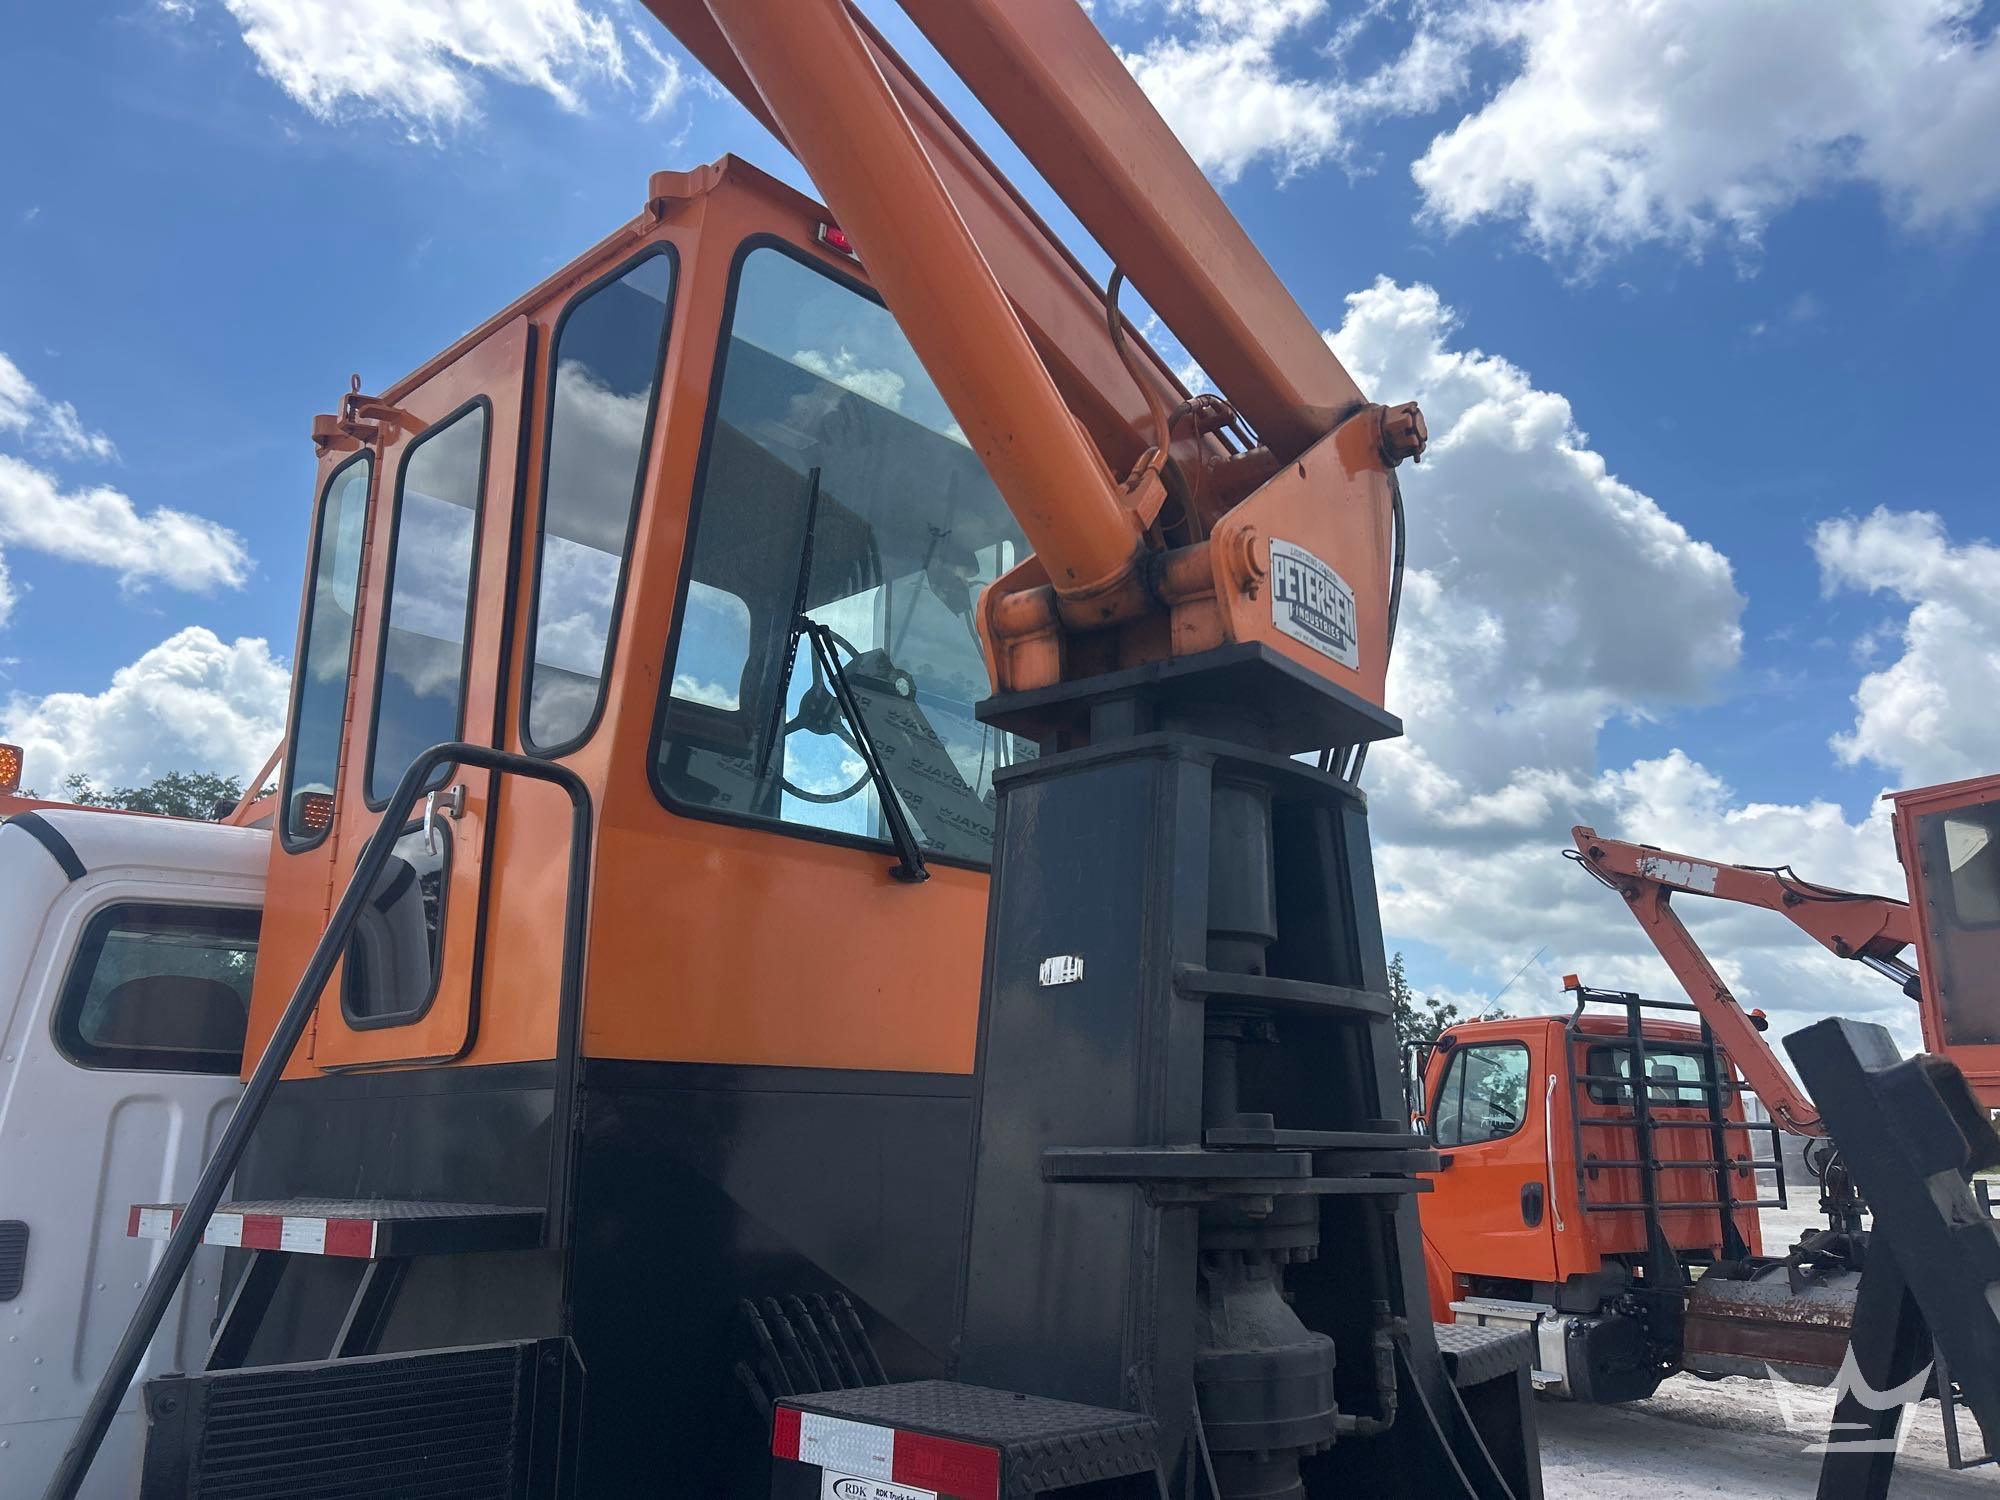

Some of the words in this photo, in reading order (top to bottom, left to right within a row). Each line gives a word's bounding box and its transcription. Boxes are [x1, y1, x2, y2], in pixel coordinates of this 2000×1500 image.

[1273, 554, 1355, 643] PETERSEN
[1295, 605, 1340, 640] INDUSTRIES
[844, 1482, 867, 1497] RDK
[875, 1488, 888, 1498] RDK
[889, 1491, 906, 1500] Truck
